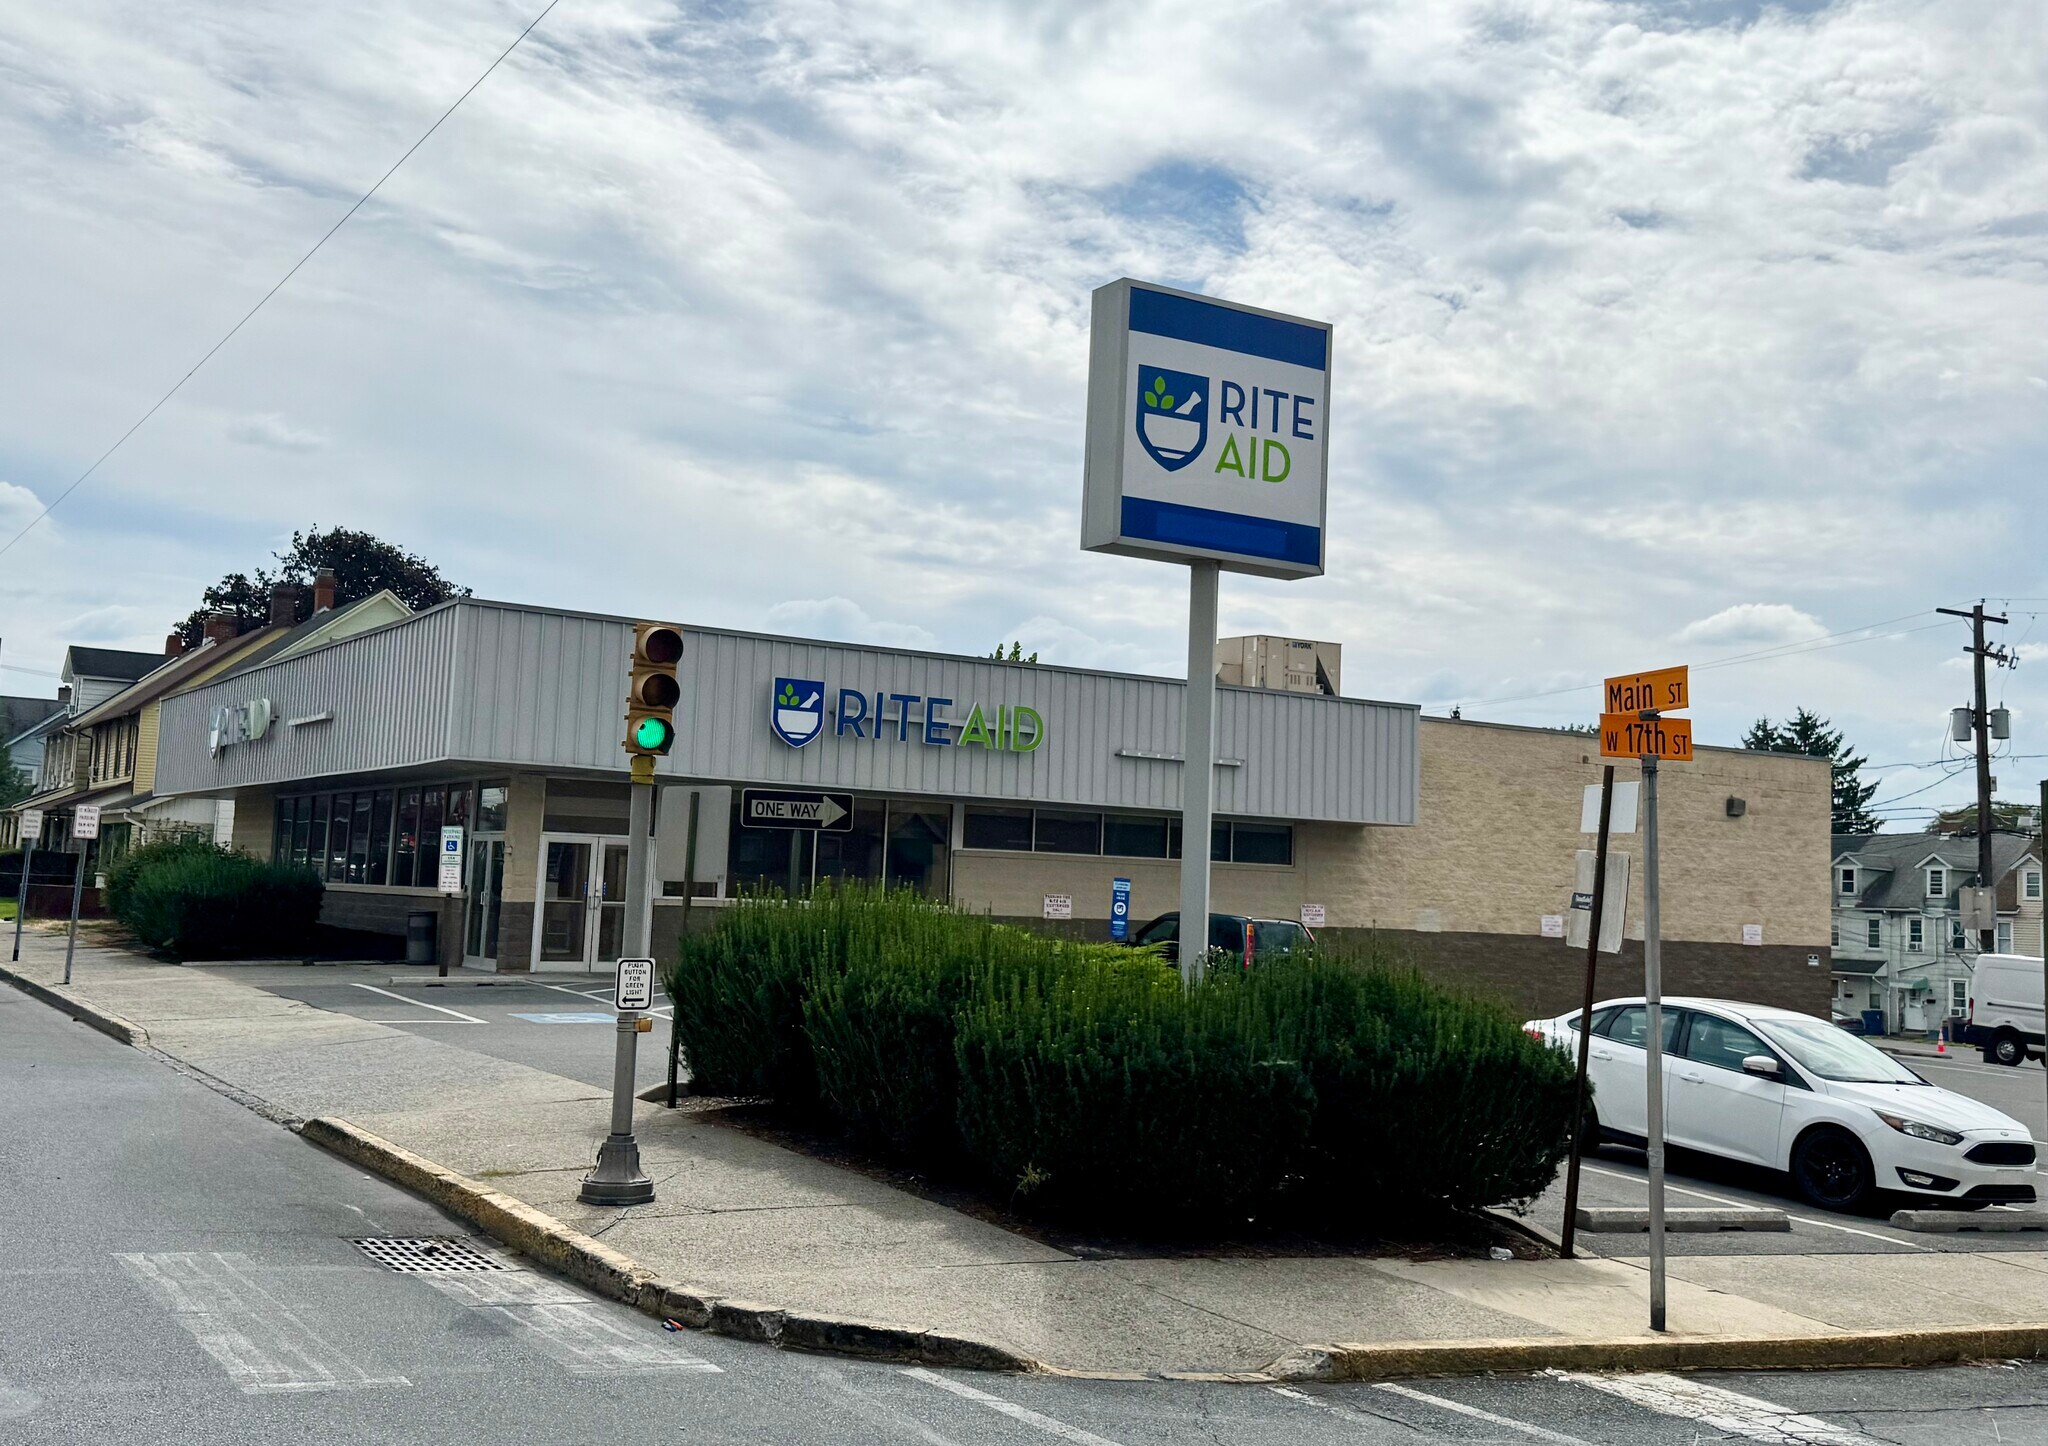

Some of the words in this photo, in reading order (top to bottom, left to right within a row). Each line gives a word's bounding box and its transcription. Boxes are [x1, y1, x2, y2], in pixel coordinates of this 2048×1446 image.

[1220, 379, 1315, 441] RITE
[1215, 432, 1291, 483] AID
[1609, 677, 1654, 713] Main
[1668, 682, 1682, 704] ST
[834, 687, 953, 746] RITE
[957, 700, 1045, 752] AID
[1606, 731, 1618, 752] W
[1625, 722, 1666, 755] 17th
[1672, 734, 1688, 755] ST
[755, 802, 785, 816] ONE
[790, 803, 820, 818] WAY
